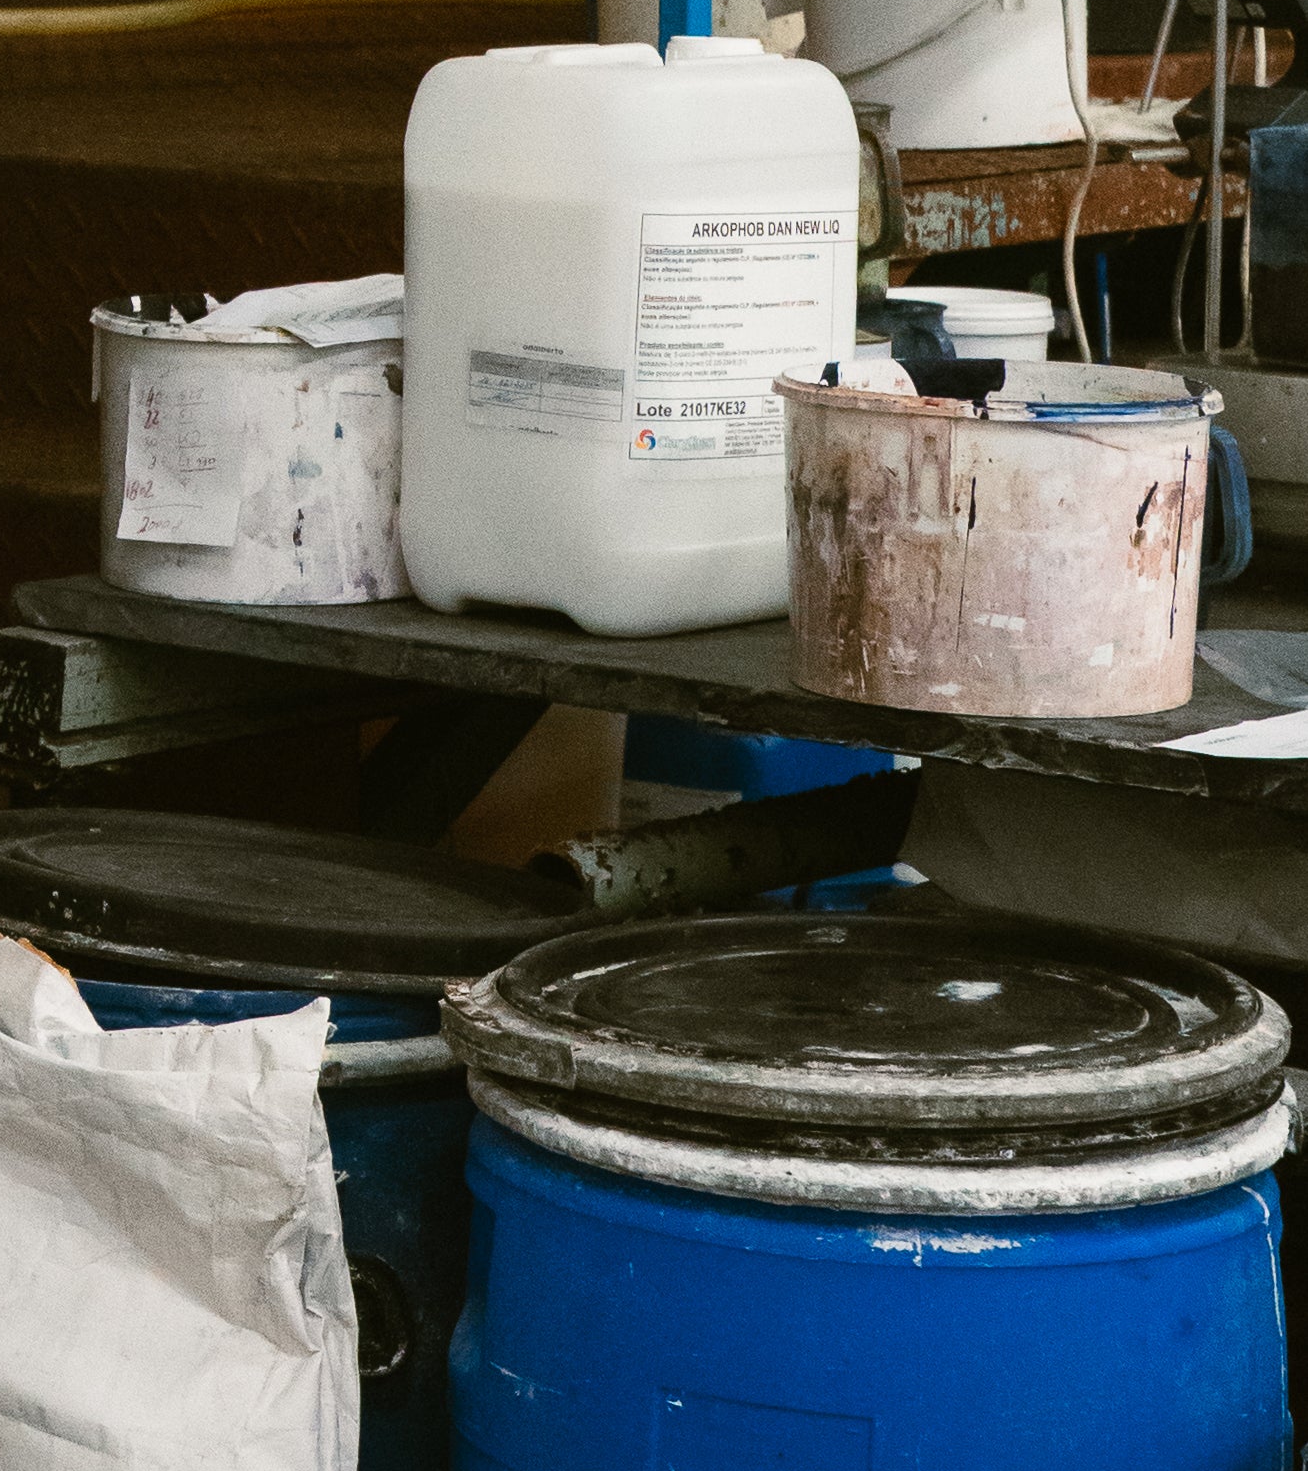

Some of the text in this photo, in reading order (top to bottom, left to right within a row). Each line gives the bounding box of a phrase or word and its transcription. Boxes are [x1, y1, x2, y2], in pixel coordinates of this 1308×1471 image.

[692, 219, 840, 238] ARKOPHOB DAN NEW LIQ
[636, 401, 747, 418] Lote 21017KE32
